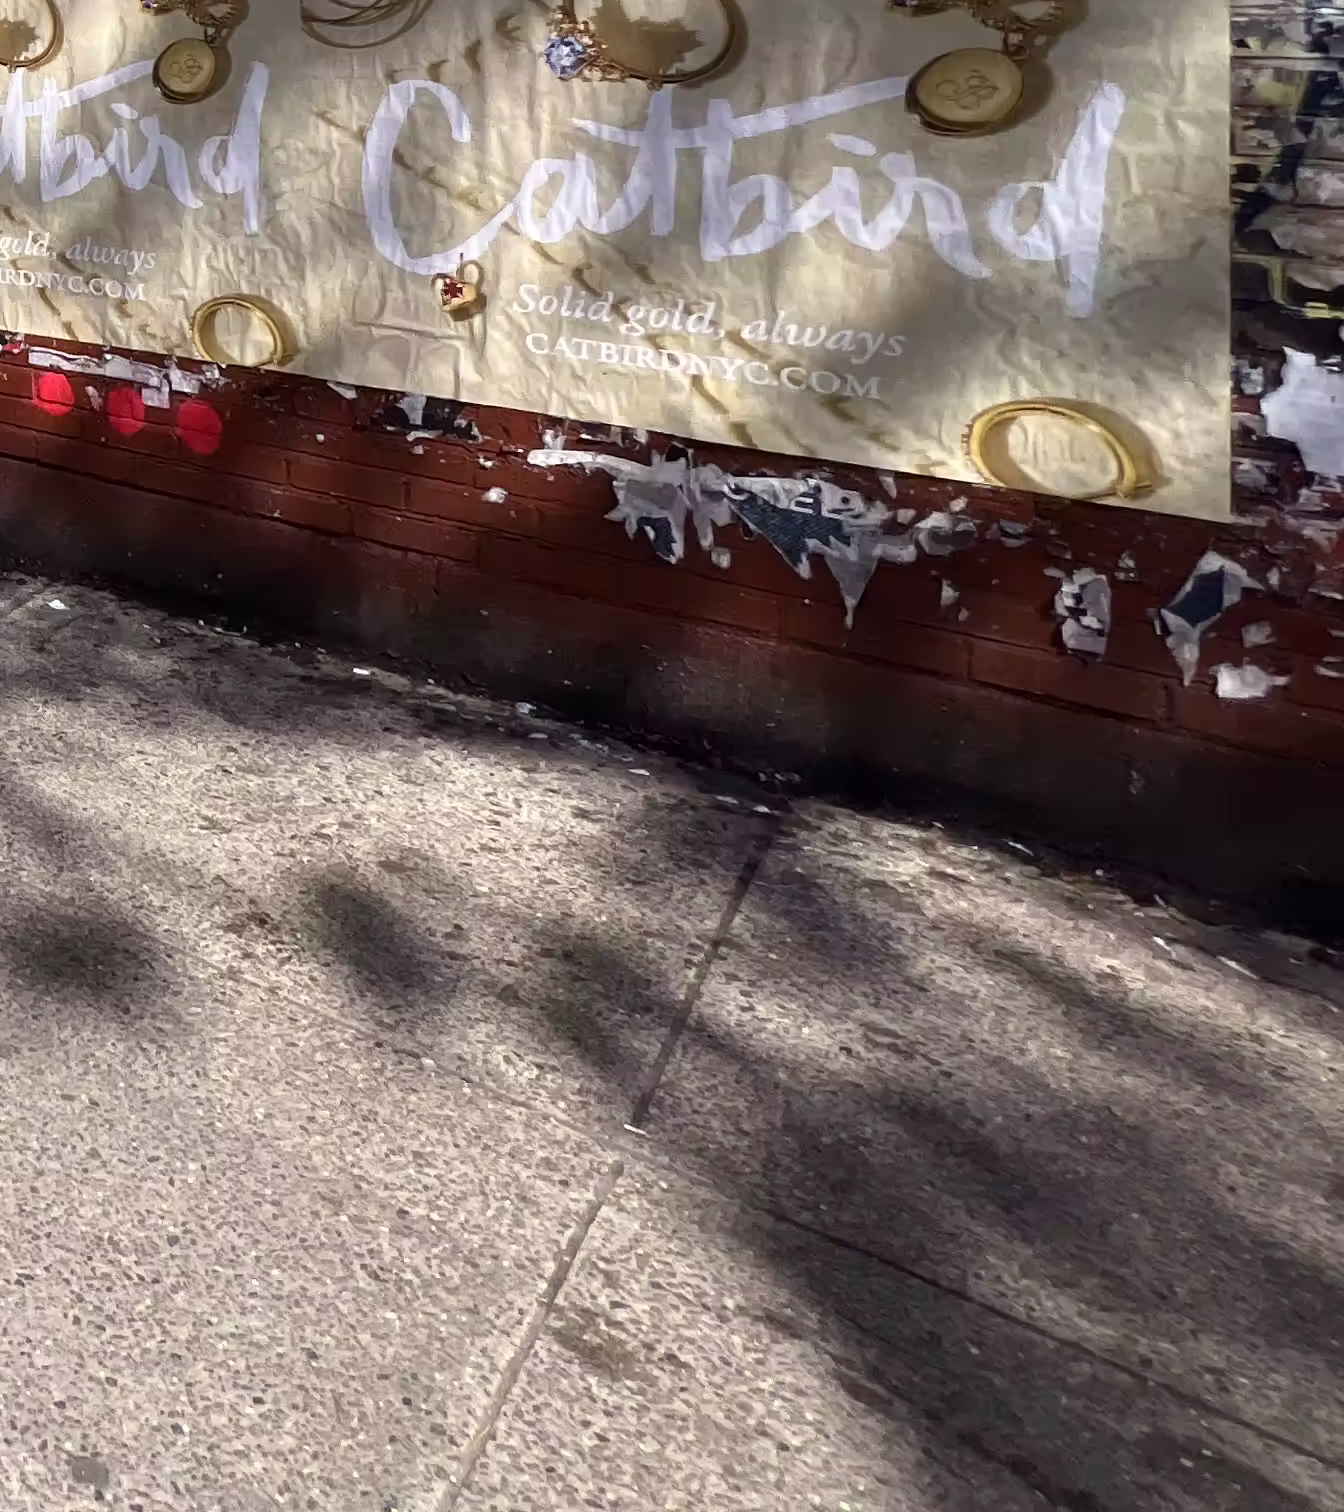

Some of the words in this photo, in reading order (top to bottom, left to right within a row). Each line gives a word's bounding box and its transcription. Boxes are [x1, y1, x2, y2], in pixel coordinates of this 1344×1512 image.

[361, 76, 1126, 318] Catbird
[65, 235, 157, 276] always
[512, 282, 614, 324] Solid
[617, 298, 726, 339] gold,
[740, 309, 908, 365] always
[524, 331, 883, 401] CATBIRDNYC.COM
